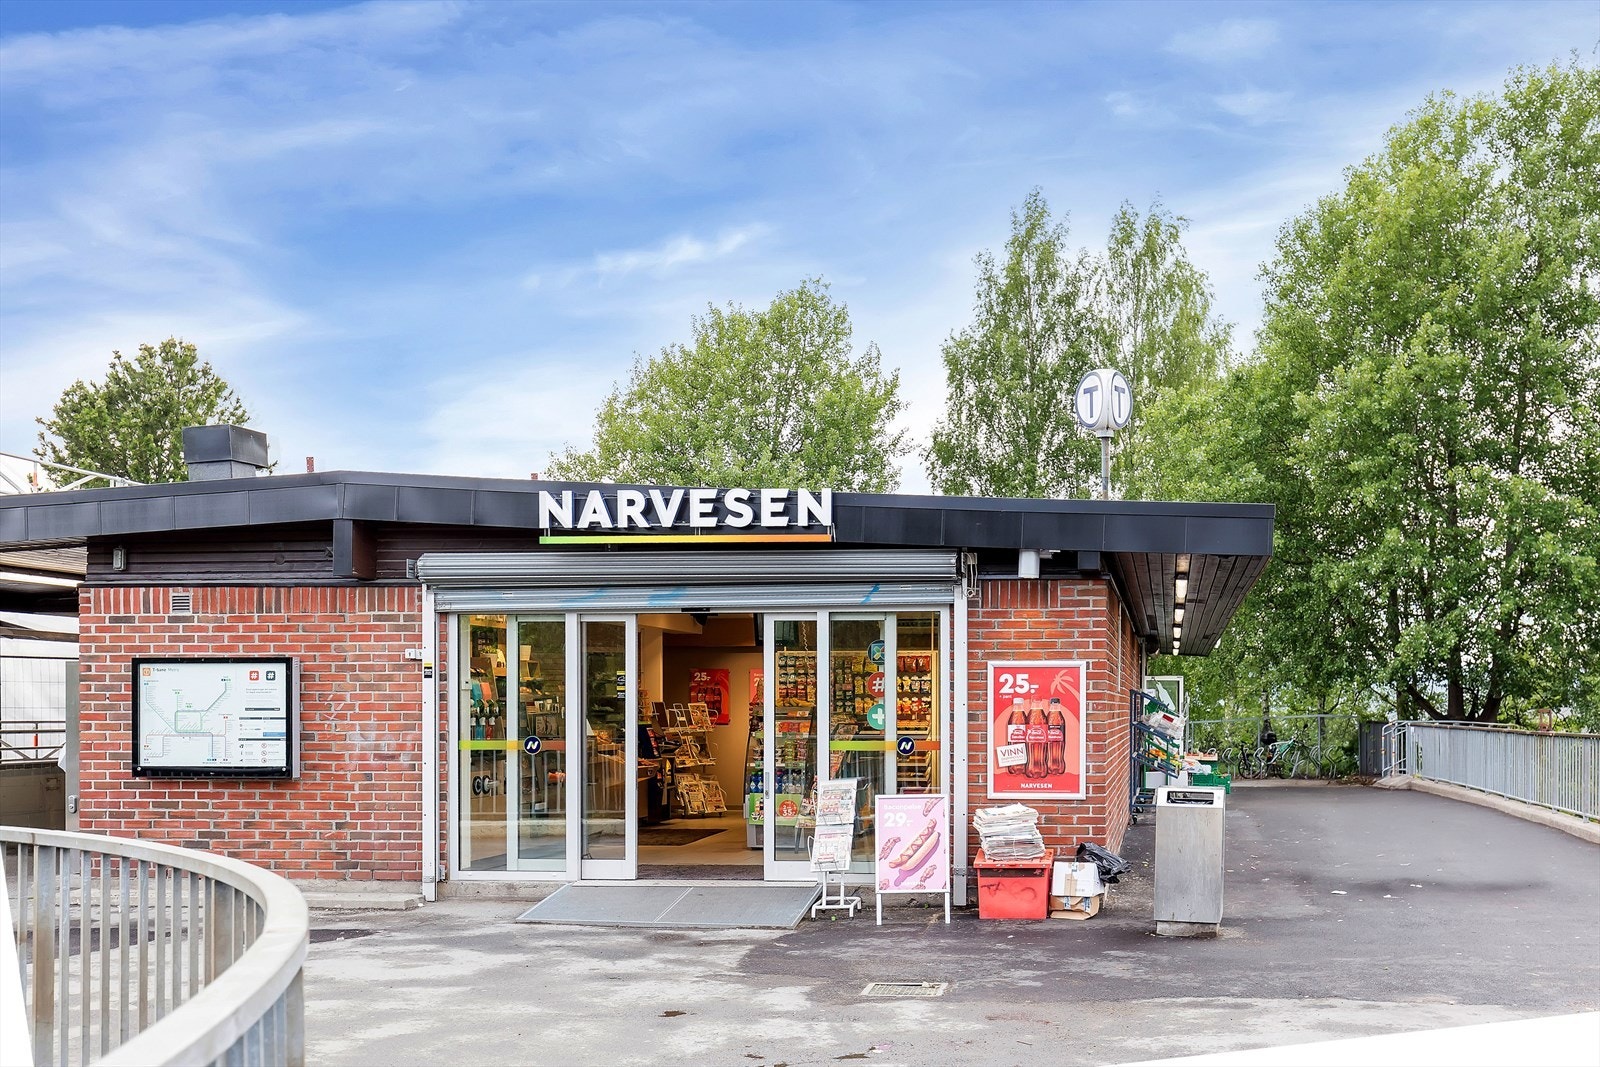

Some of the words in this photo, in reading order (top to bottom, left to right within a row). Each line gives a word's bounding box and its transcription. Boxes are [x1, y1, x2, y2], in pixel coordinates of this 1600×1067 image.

[1083, 385, 1098, 418] T
[1114, 385, 1125, 418] T
[539, 488, 833, 529] NARVESEN
[1000, 747, 1024, 757] VINN
